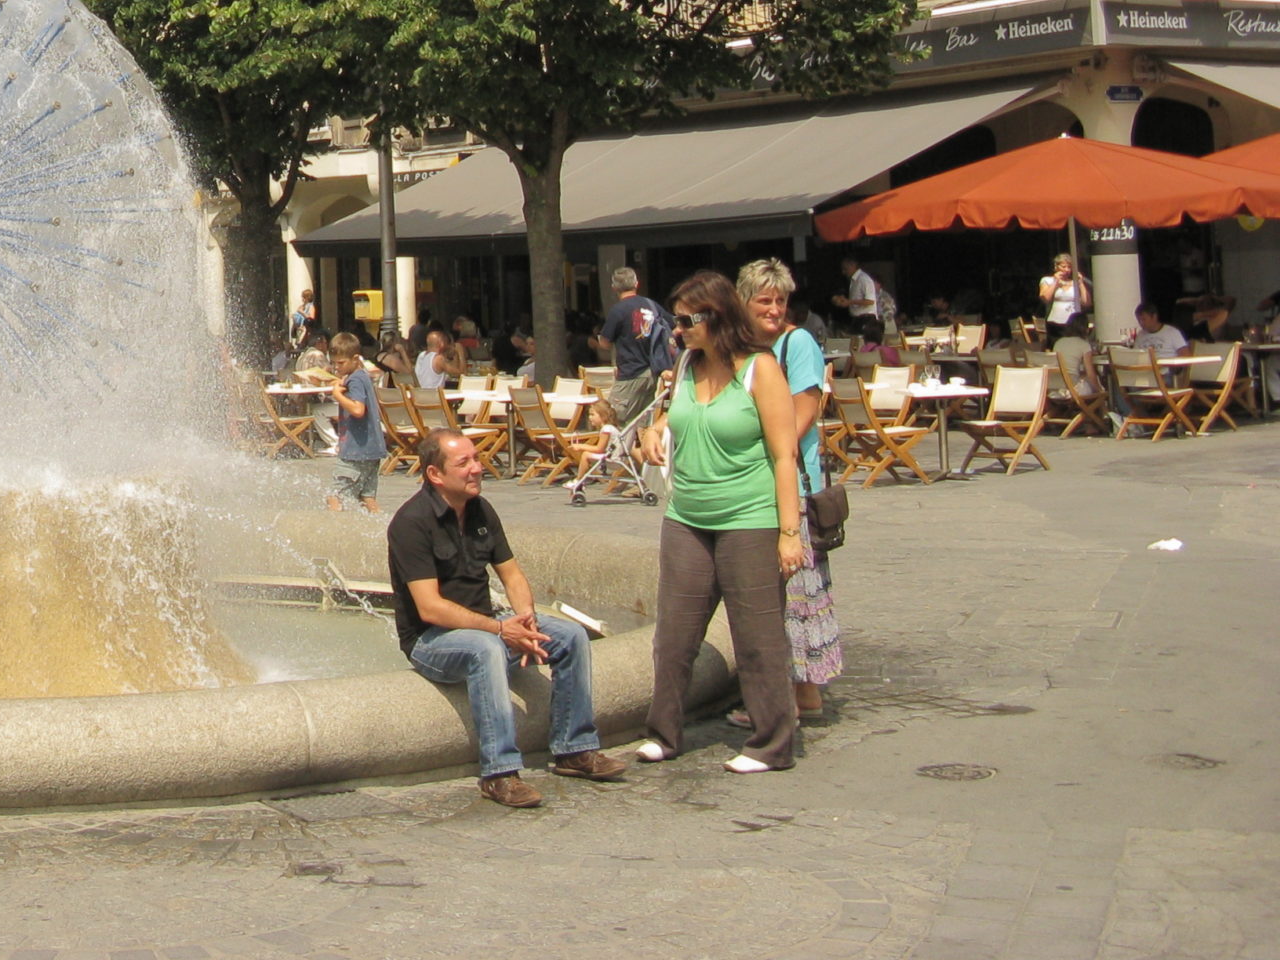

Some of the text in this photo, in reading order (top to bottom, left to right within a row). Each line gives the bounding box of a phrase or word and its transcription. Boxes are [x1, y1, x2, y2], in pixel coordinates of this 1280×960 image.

[1008, 16, 1074, 39] Heineken
[1129, 10, 1188, 29] Heineken
[946, 26, 980, 52] Bar
